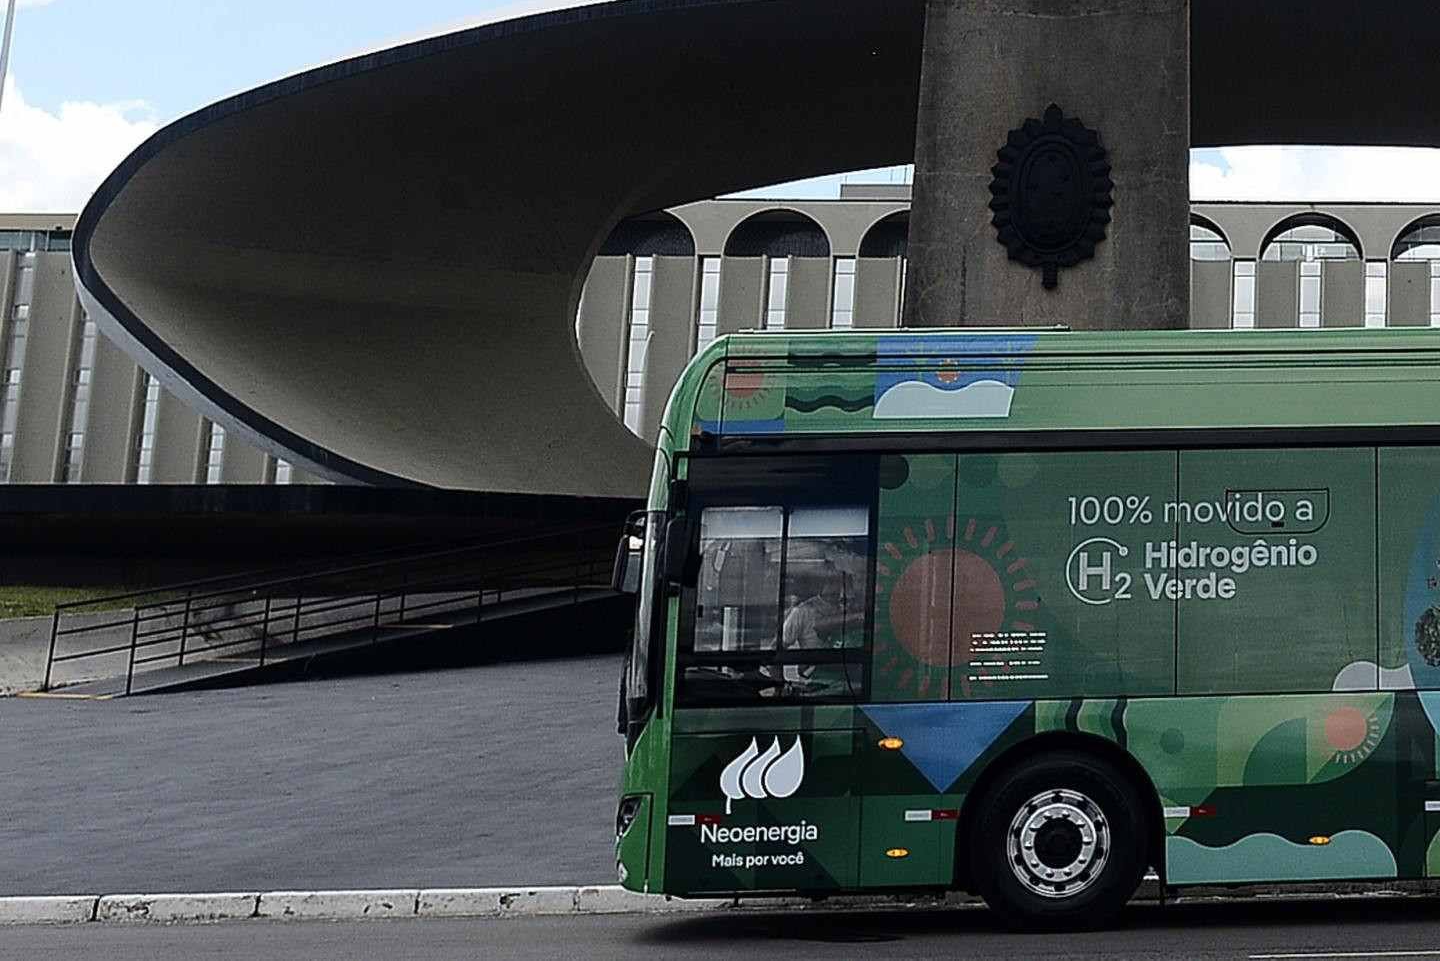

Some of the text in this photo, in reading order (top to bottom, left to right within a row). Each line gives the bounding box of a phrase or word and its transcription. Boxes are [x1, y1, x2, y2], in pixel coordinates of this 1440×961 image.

[1068, 493, 1313, 525] 100% movido a
[1145, 539, 1318, 573] Hidrogênio
[1144, 572, 1236, 600] Verde
[701, 820, 818, 844] Neoenergia
[712, 851, 804, 869] Mais por você
